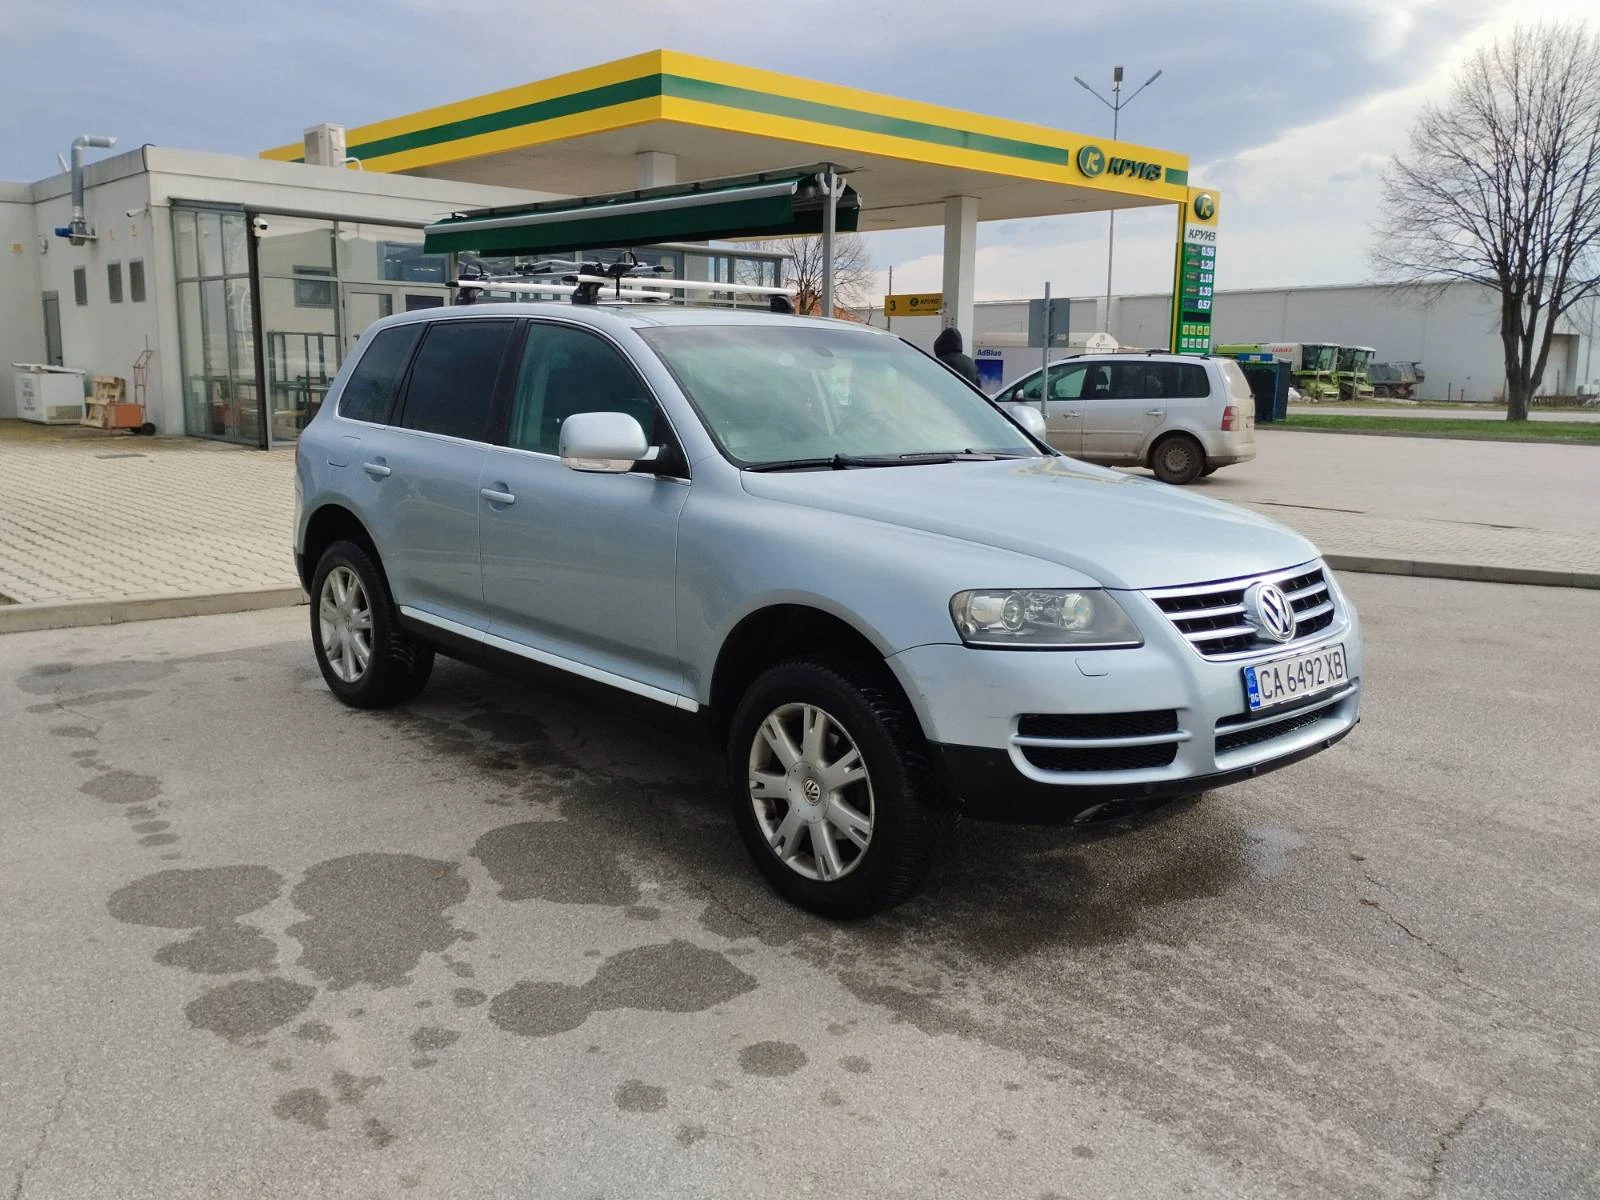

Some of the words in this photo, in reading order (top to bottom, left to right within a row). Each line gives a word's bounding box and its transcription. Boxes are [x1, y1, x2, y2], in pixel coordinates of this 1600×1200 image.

[1107, 156, 1162, 181] КРУИЗ
[1188, 229, 1216, 241] КРУИЗ
[889, 300, 896, 311] 3
[1197, 299, 1211, 309] 0.57
[977, 349, 1002, 357] AdBlue
[1250, 693, 1260, 702] BG
[1260, 667, 1285, 699] CA
[1287, 657, 1325, 692] 6492
[1324, 651, 1343, 682] XB
